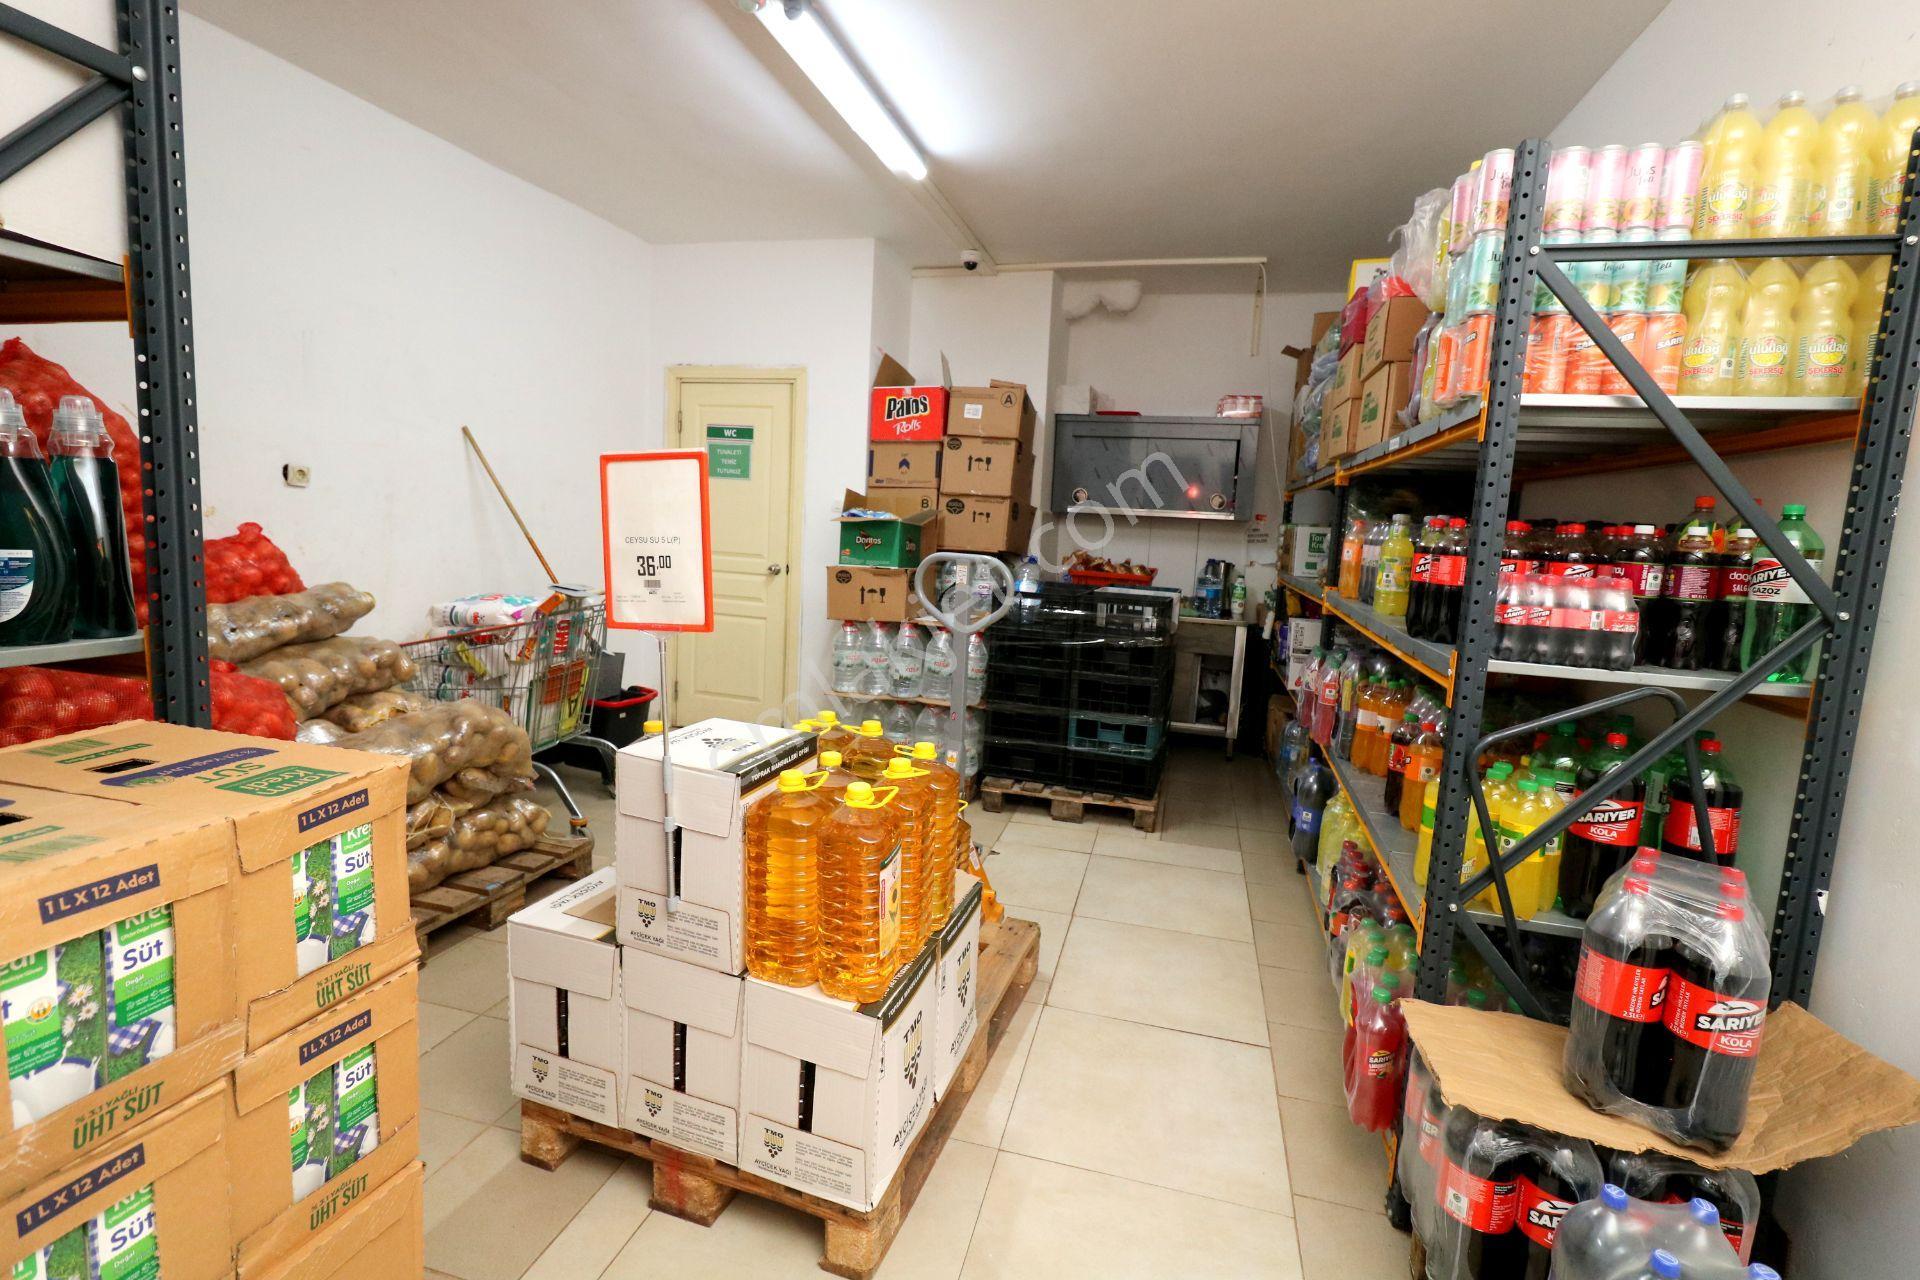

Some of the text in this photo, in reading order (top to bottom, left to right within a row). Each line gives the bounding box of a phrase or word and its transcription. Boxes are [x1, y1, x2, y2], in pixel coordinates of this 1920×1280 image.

[1750, 342, 1788, 356] uludağ
[1808, 342, 1849, 356] uludağ
[1004, 394, 1013, 405] A
[723, 429, 737, 437] WC
[892, 419, 922, 435] Rolls
[921, 499, 930, 509] B
[624, 536, 648, 545] CEYSU
[649, 536, 661, 545] SU
[855, 535, 883, 546] Doritos
[636, 555, 672, 578] 36,00
[1752, 568, 1790, 586] ARIYE
[194, 762, 267, 785] SÜT
[310, 811, 318, 822] L
[327, 803, 340, 814] 12
[340, 793, 366, 810] Adet
[1589, 825, 1619, 839] KOLA
[345, 851, 371, 873] Süt
[45, 871, 156, 915] 1 L X 12 Adet
[637, 898, 657, 908] TMO
[122, 939, 164, 971] Süt
[957, 941, 972, 966] TMO
[316, 963, 372, 1008] UHT SÜT
[903, 1009, 923, 1043] TMO
[1696, 1010, 1766, 1032] SARIYE
[310, 1043, 318, 1054] L
[329, 1030, 341, 1043] 12
[343, 1015, 369, 1035] Adet
[1720, 1036, 1753, 1049] KOLA
[532, 1055, 550, 1065] TMO
[346, 1062, 372, 1089] Süt
[645, 1088, 664, 1099] TMO
[73, 1080, 165, 1150] UHT SÜT
[763, 1128, 785, 1139] TMO
[38, 1205, 50, 1219] L
[72, 1182, 94, 1198] 12
[98, 1151, 139, 1184] Adet
[309, 1174, 369, 1232] UHT SÜT
[110, 1212, 156, 1253] Süt
